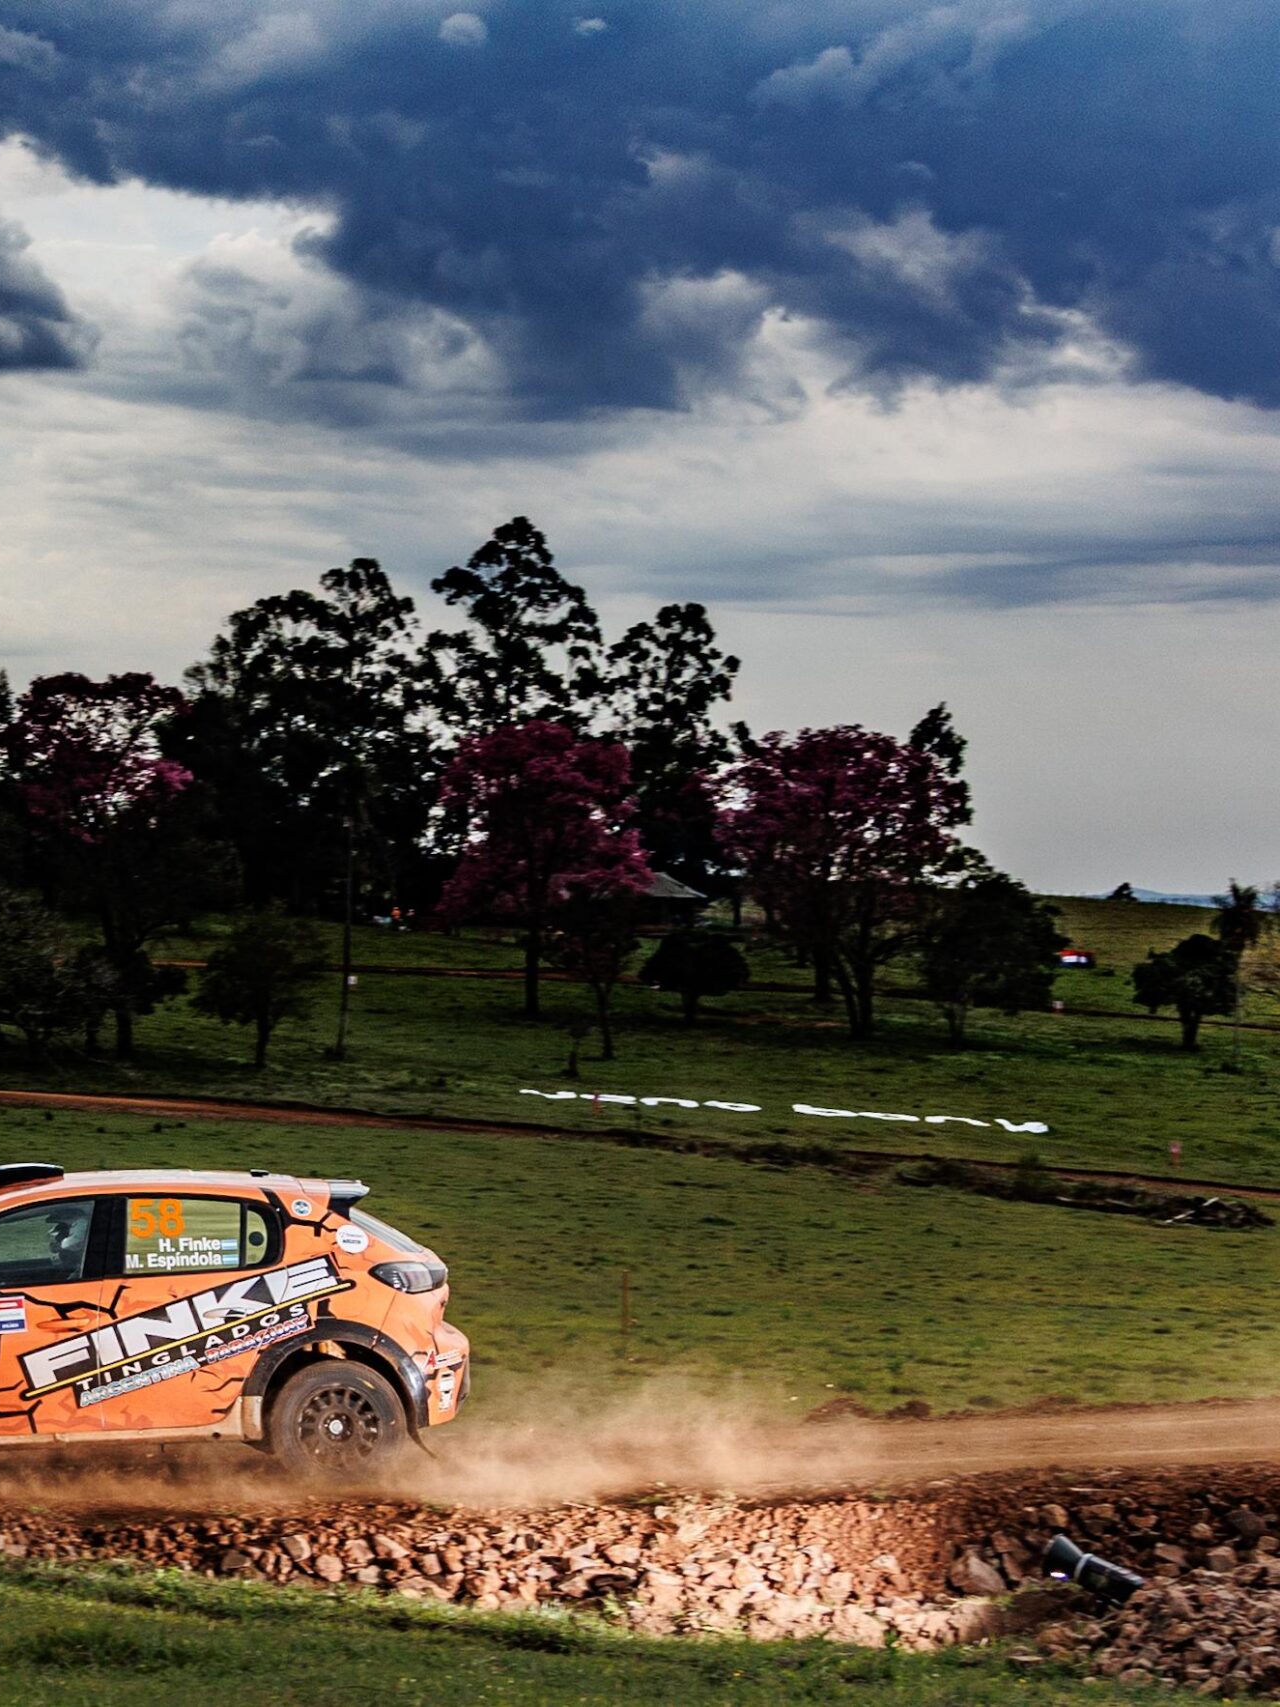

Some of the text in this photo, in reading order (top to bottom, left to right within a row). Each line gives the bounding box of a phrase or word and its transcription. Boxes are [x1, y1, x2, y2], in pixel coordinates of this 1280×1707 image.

[130, 1198, 185, 1239] 58
[124, 1251, 223, 1271] M. Espíndola
[158, 1236, 221, 1252] H. Finke
[23, 1257, 338, 1390] FINKE
[76, 1302, 306, 1391] TINGLADOS
